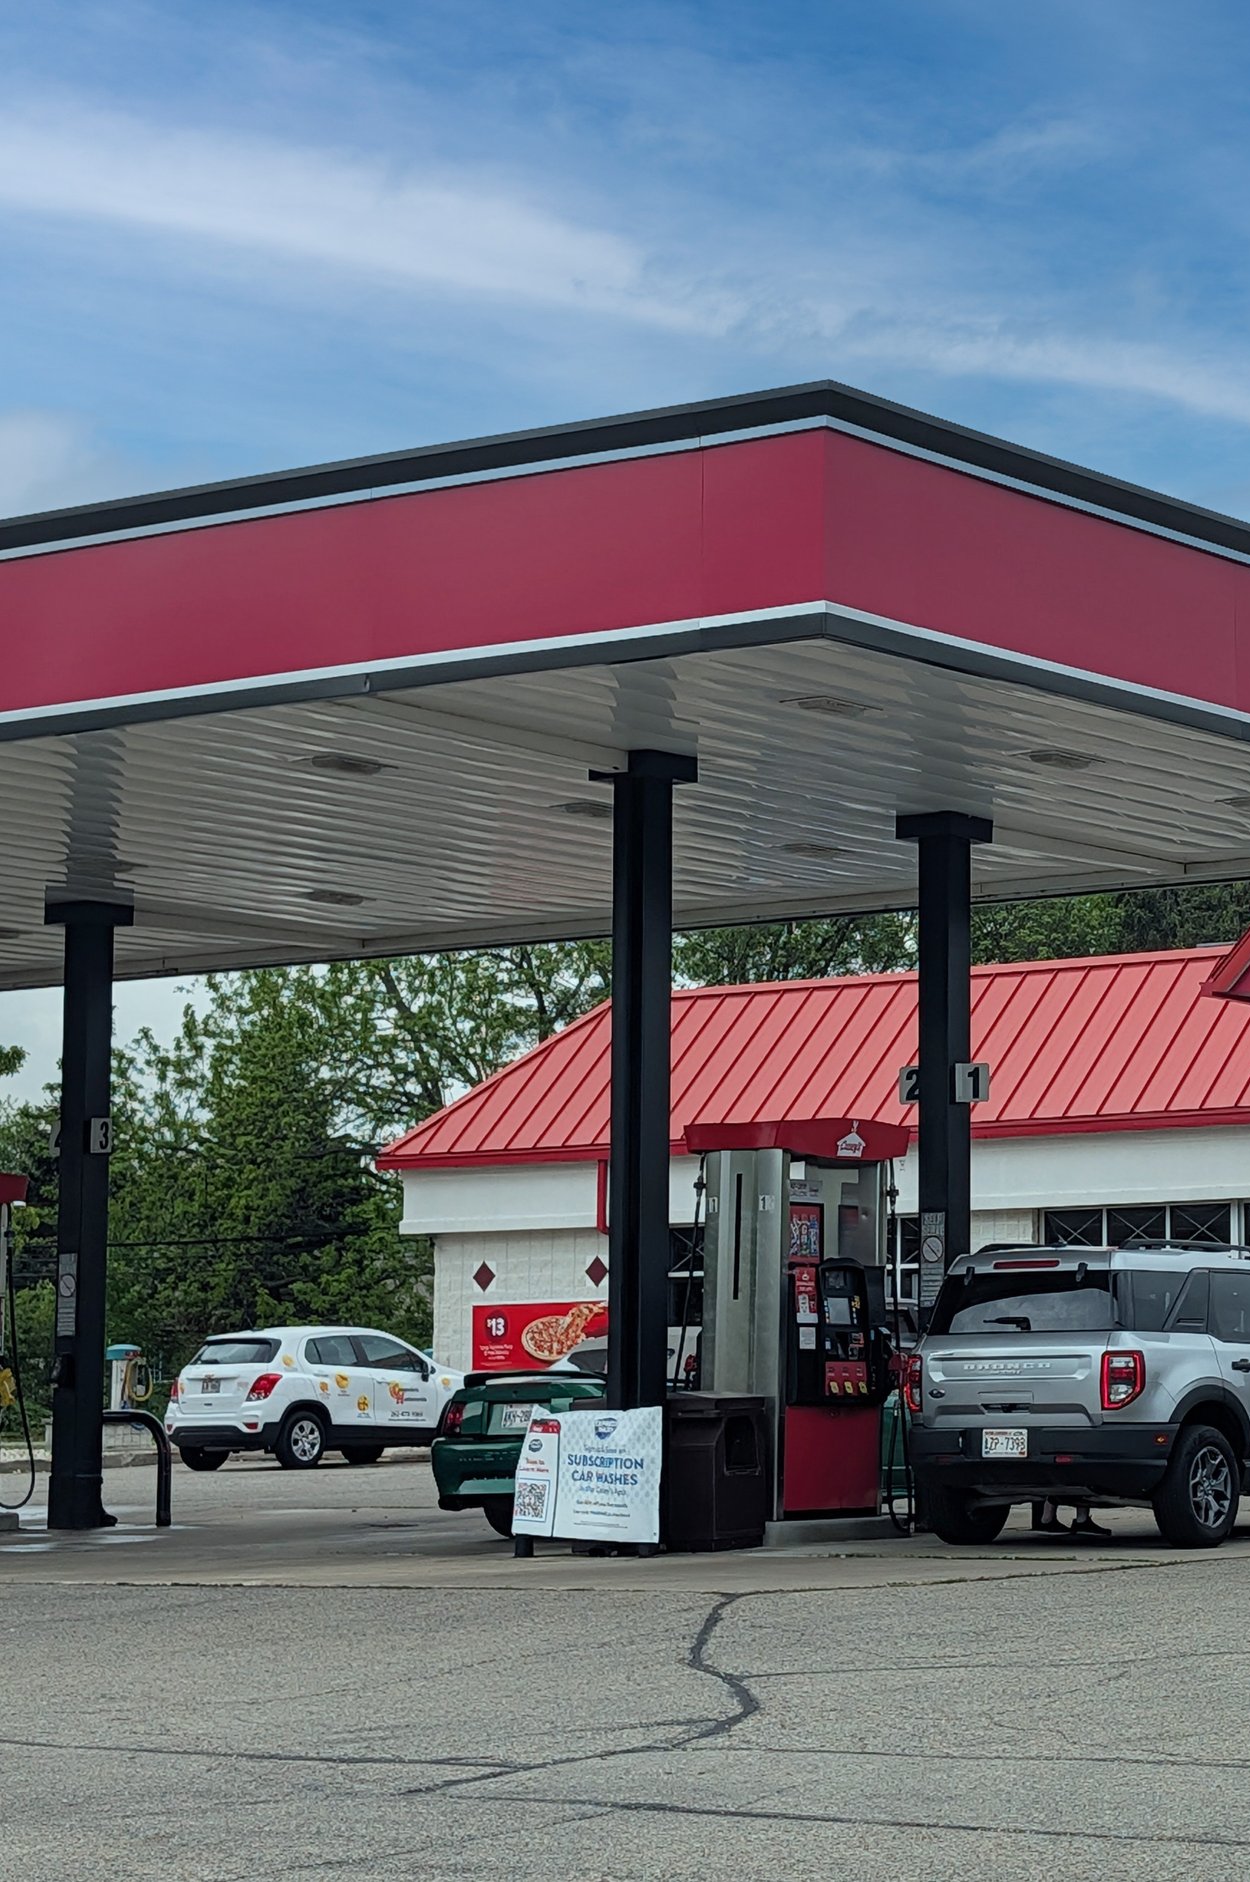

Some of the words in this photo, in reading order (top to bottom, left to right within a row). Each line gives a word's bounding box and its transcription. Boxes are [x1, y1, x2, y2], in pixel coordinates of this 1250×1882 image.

[905, 1070, 919, 1101] 2
[967, 1067, 980, 1099] 1
[99, 1120, 109, 1150] 3
[487, 1317, 505, 1337] $13
[963, 1362, 1051, 1371] BRONCO
[567, 1453, 645, 1470] SUBSCRIPTION
[571, 1470, 594, 1483] CAR
[595, 1471, 639, 1486] WASHES
